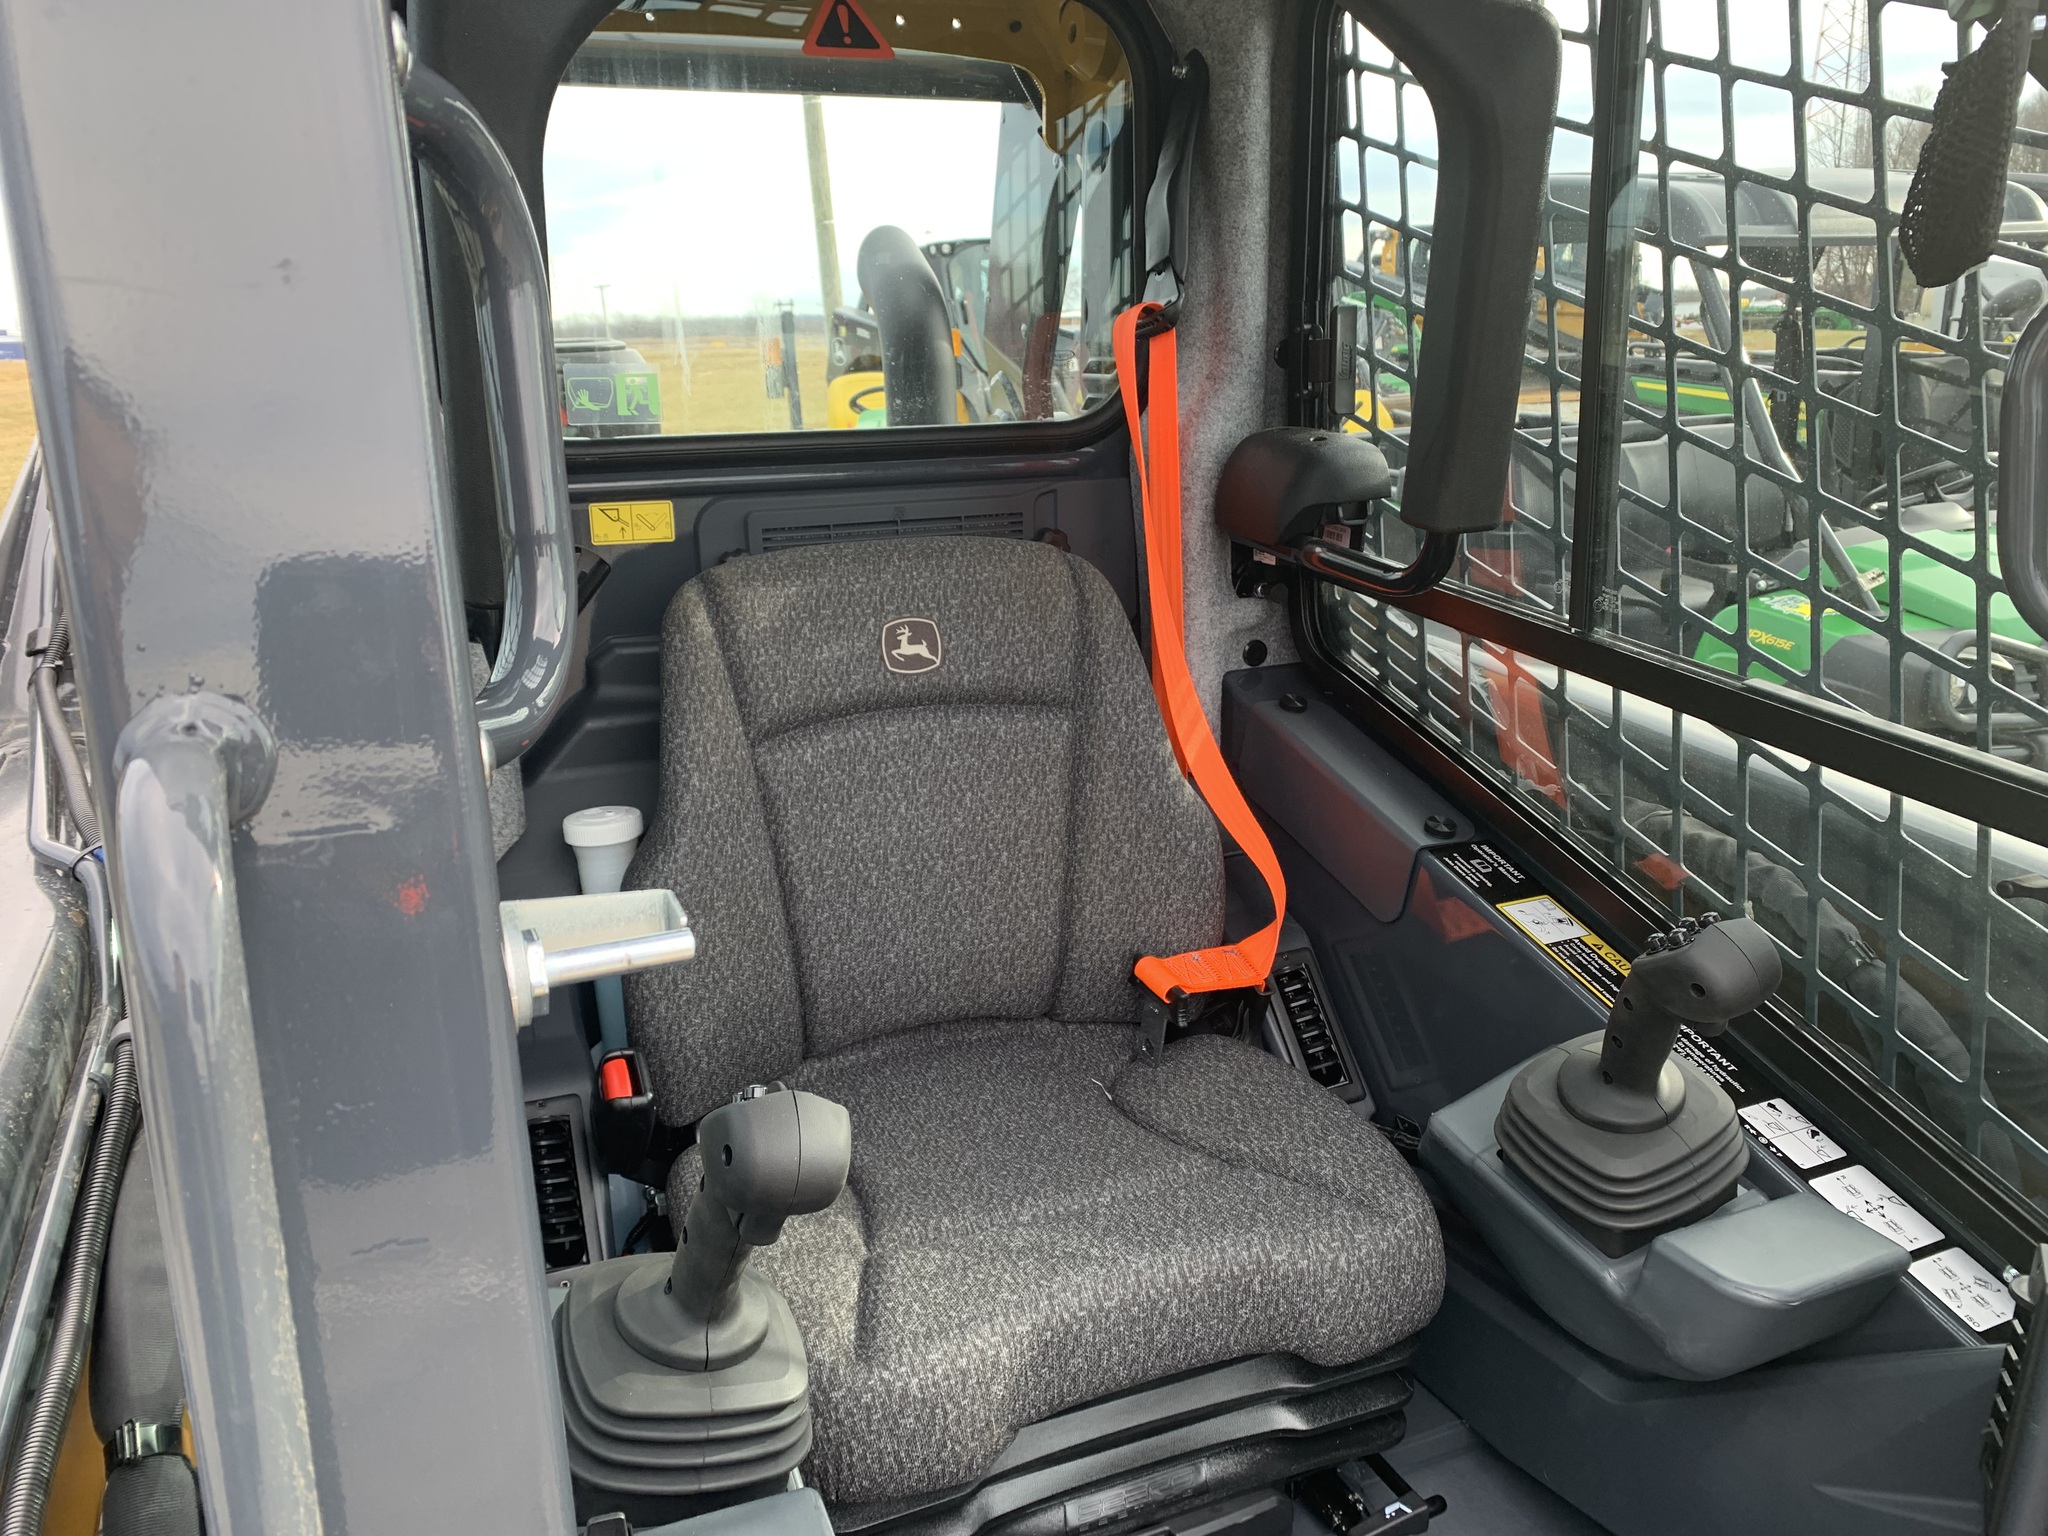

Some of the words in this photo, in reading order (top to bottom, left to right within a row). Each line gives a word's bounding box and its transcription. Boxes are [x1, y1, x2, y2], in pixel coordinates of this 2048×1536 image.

[1480, 845, 1525, 879] IMPORTANT
[1498, 867, 1519, 883] Manual
[1572, 939, 1592, 953] Avoid
[1590, 953, 1617, 976] Overturn
[1680, 1024, 1738, 1071] MPORTANT
[1681, 1037, 1705, 1058] damage
[1682, 1047, 1725, 1082] temperatures
[1964, 1314, 1981, 1328] ISO
